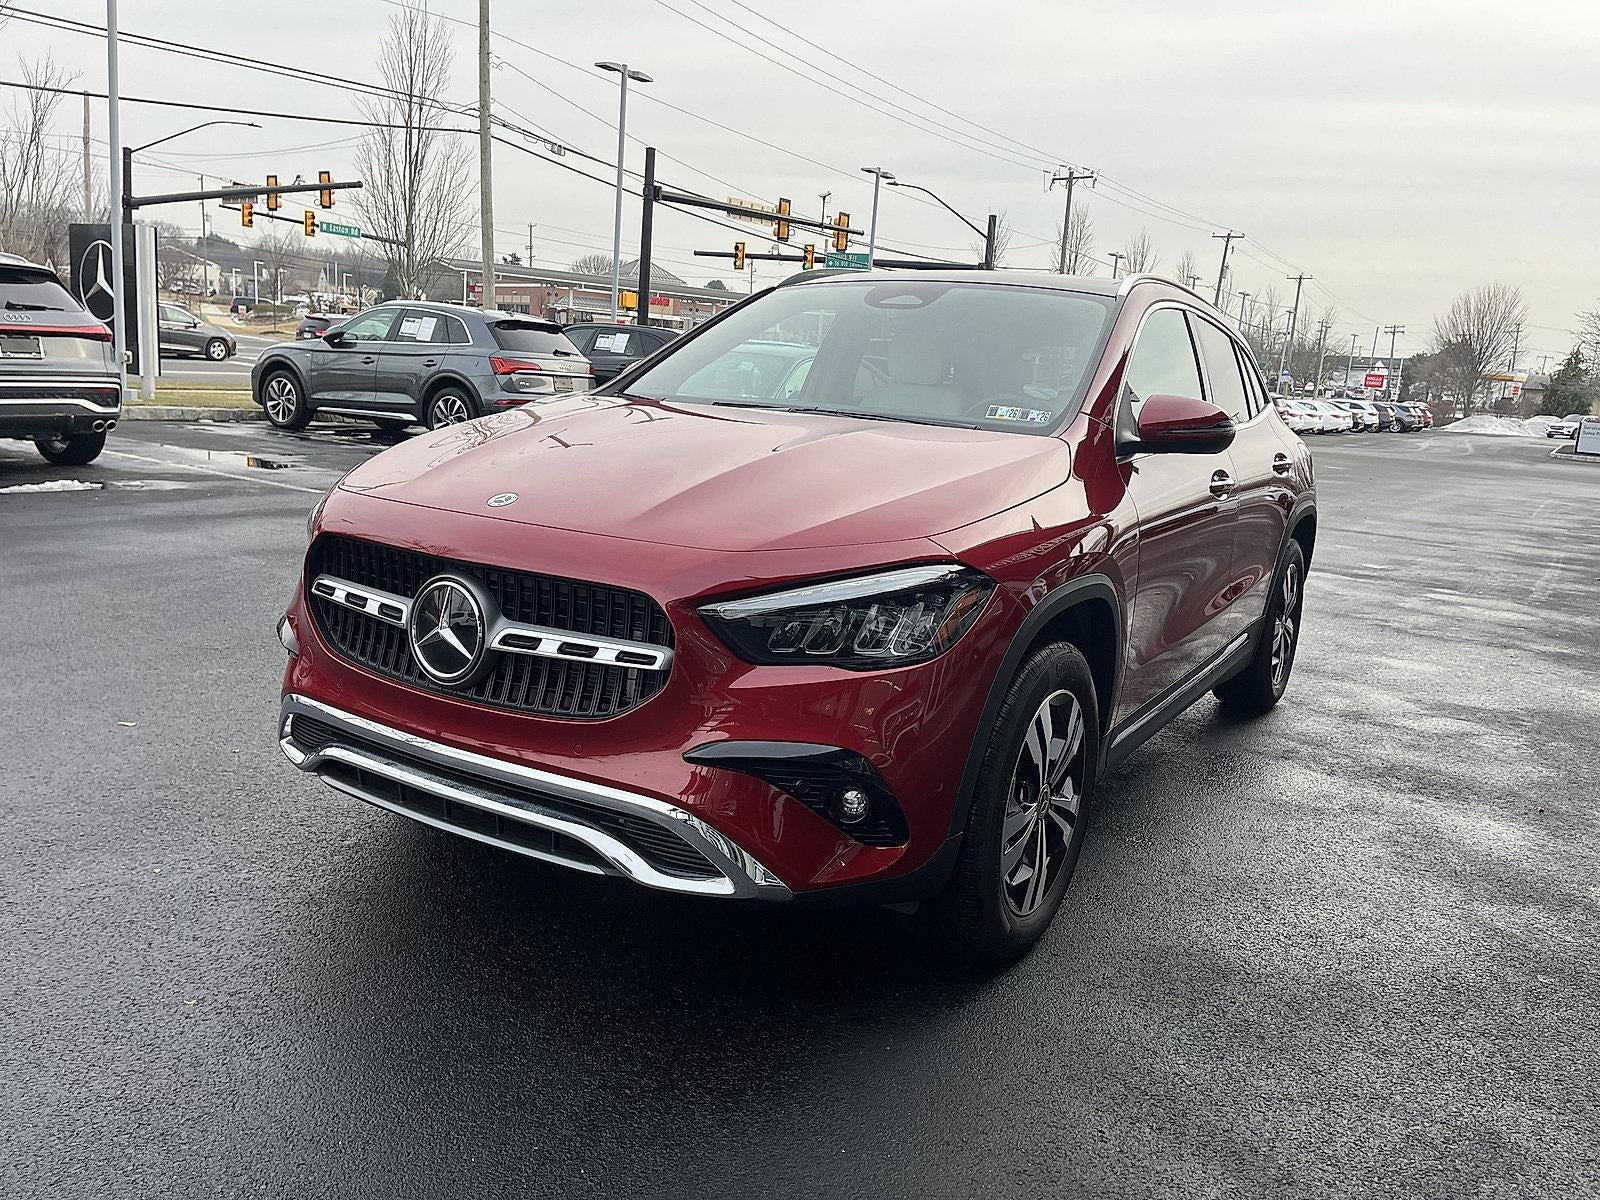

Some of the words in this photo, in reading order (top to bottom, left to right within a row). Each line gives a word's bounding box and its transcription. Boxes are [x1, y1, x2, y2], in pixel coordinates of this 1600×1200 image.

[329, 224, 349, 234] Easton
[350, 226, 359, 236] Rd
[1008, 408, 1019, 418] 26
